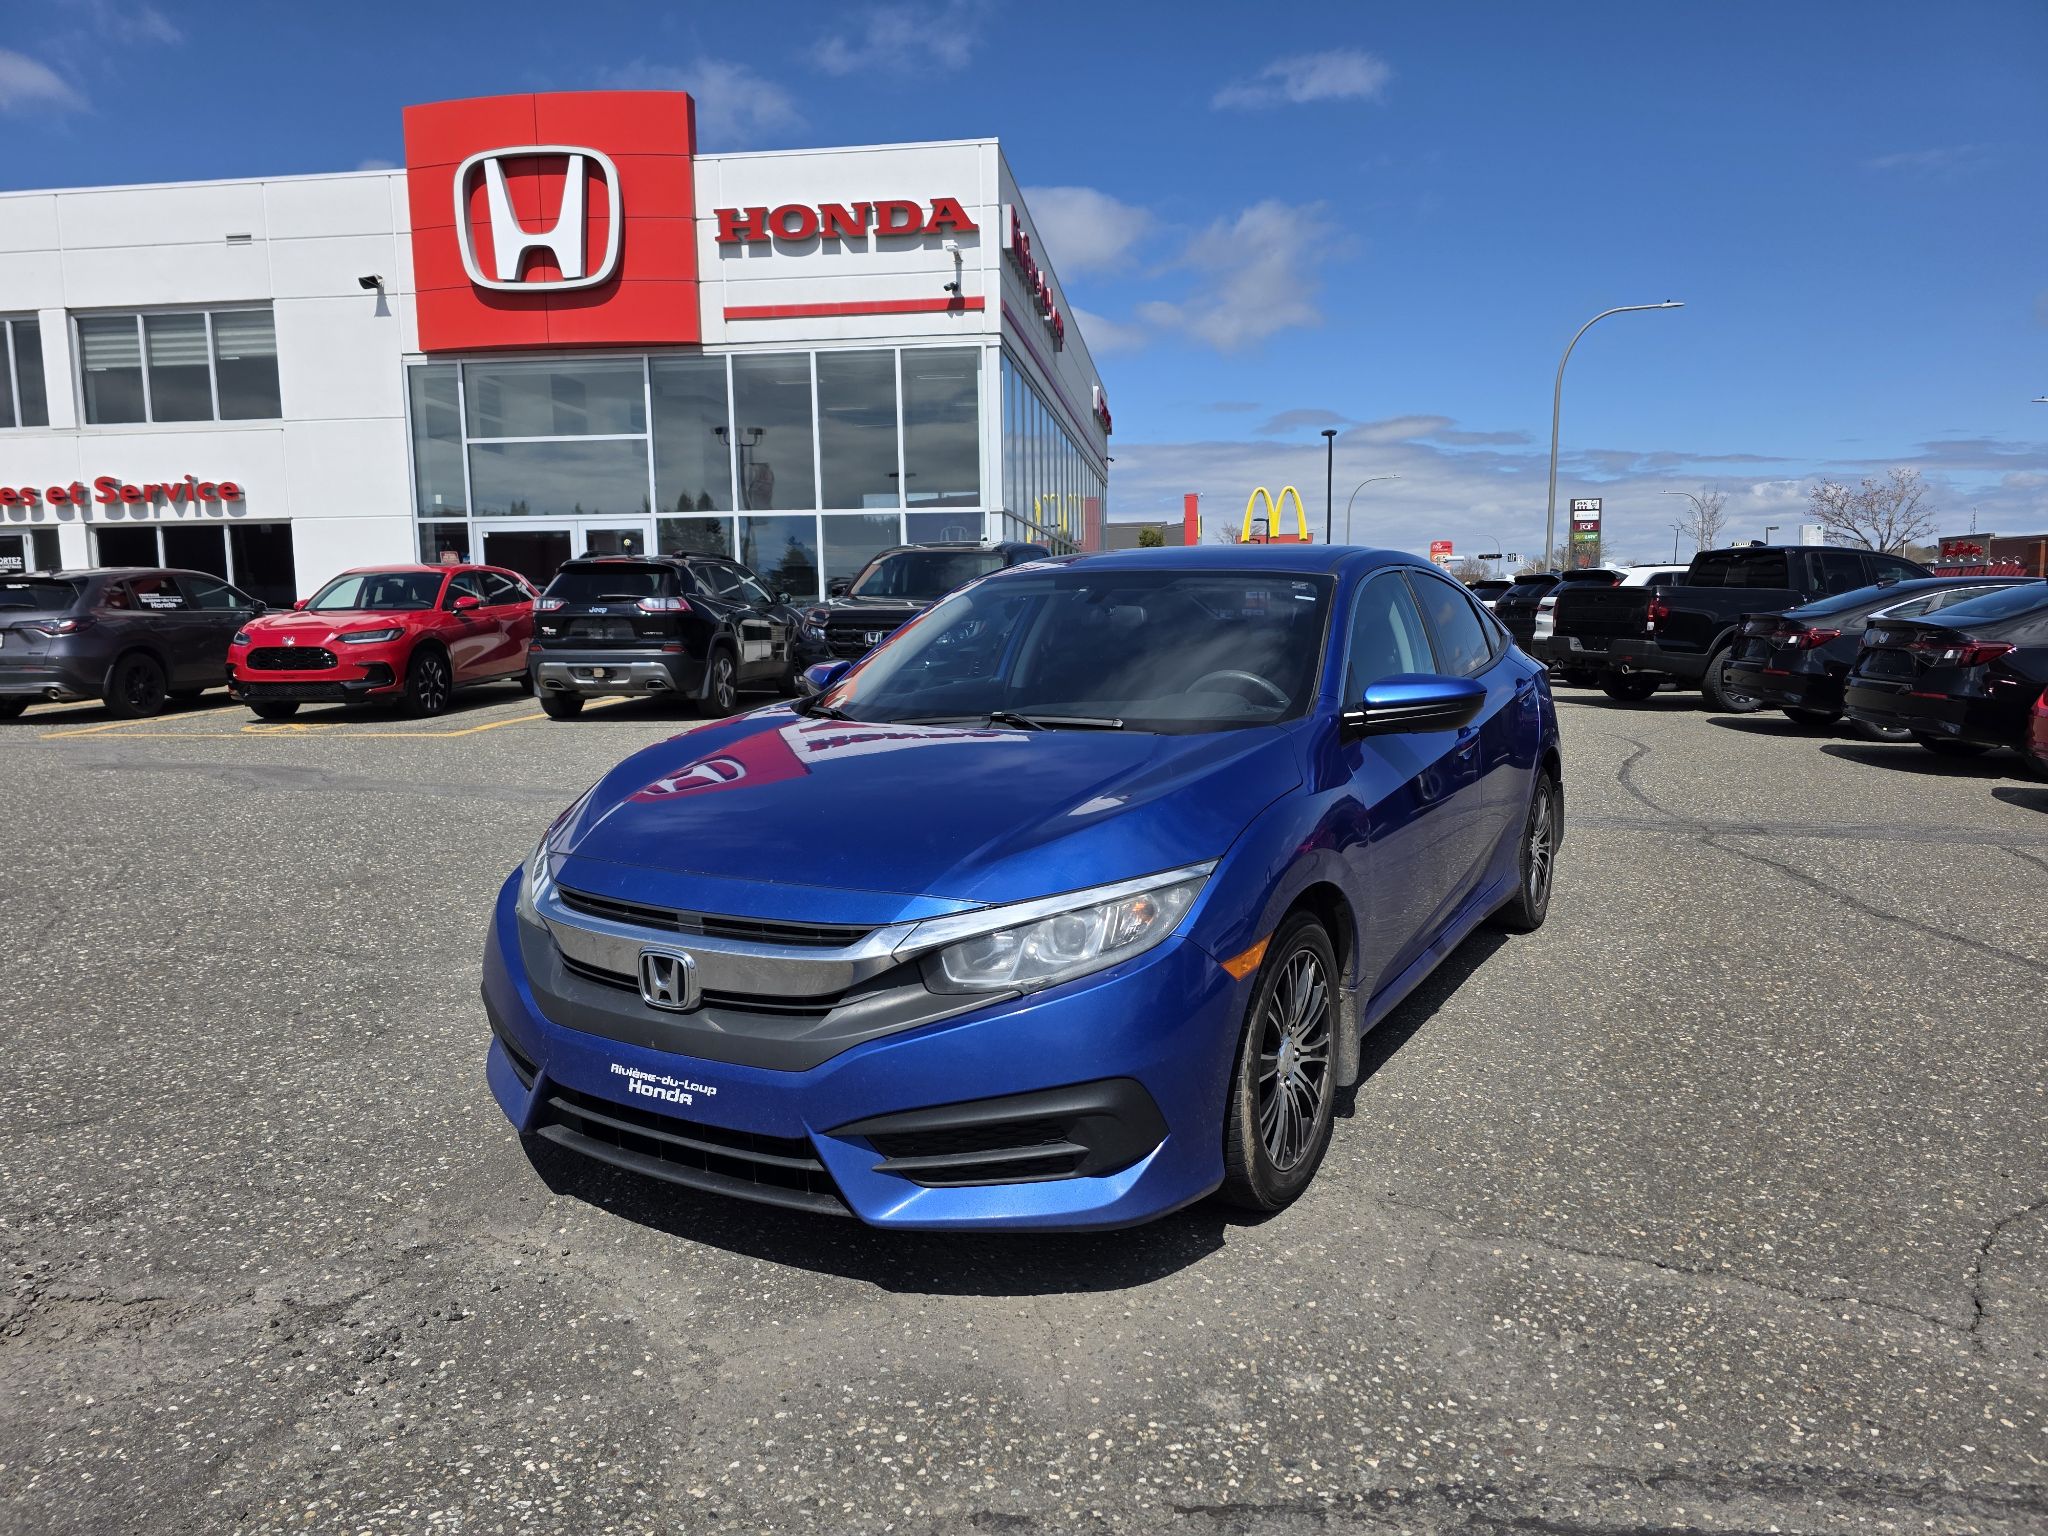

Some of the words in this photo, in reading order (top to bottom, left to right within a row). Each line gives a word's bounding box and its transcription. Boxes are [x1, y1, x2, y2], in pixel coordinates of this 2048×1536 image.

[713, 197, 980, 243] HONDA
[46, 481, 85, 505] et
[94, 474, 240, 504] Service
[588, 606, 608, 614] Jeep
[628, 1077, 693, 1106] Honda
